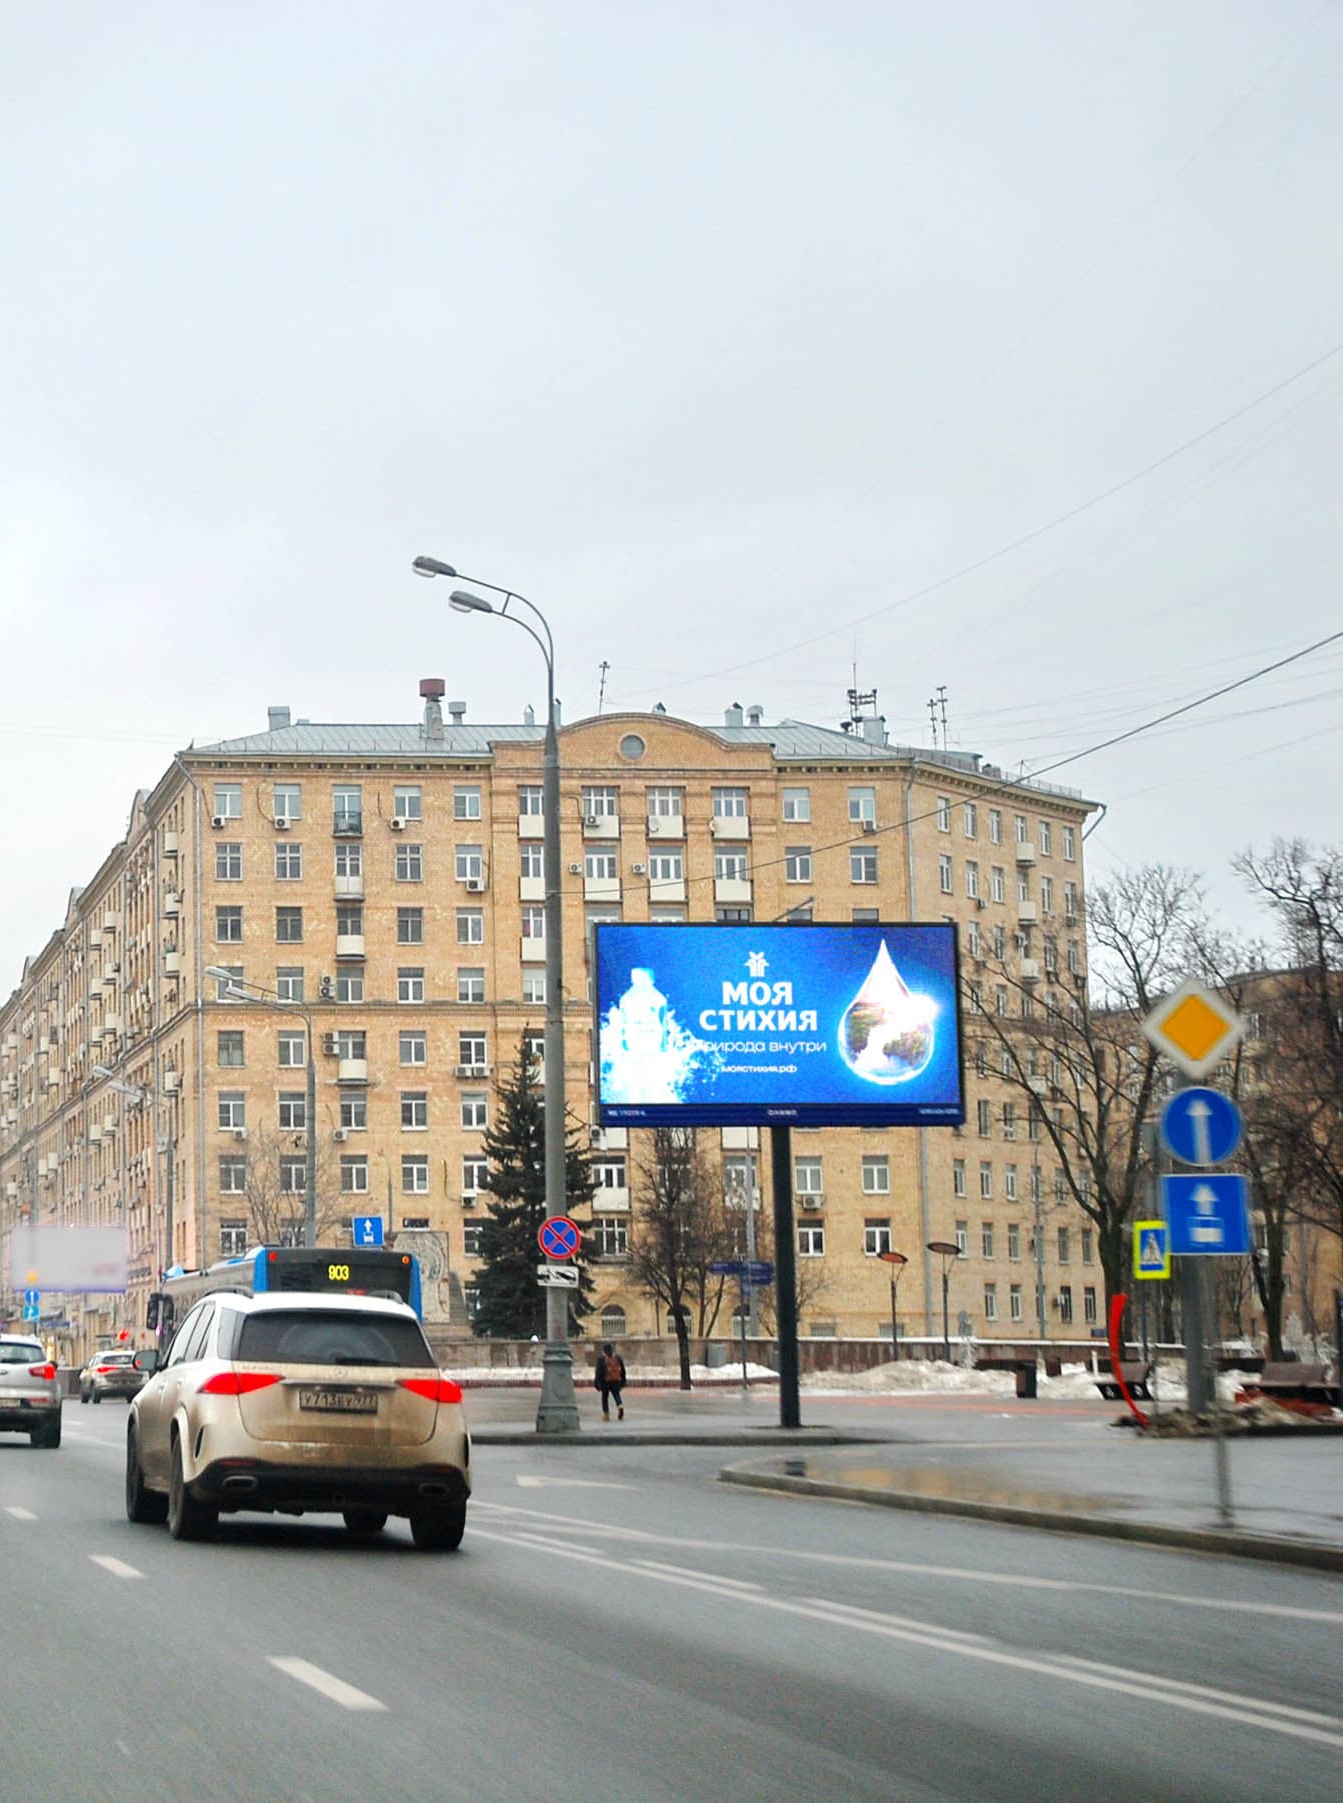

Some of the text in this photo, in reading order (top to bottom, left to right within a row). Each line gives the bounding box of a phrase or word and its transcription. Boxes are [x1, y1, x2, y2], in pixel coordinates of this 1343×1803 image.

[721, 981, 794, 1006] МОЯ
[699, 1009, 818, 1032] СТИХИЯ
[694, 1041, 827, 1054] рирода внутри
[328, 1264, 350, 1281] 903
